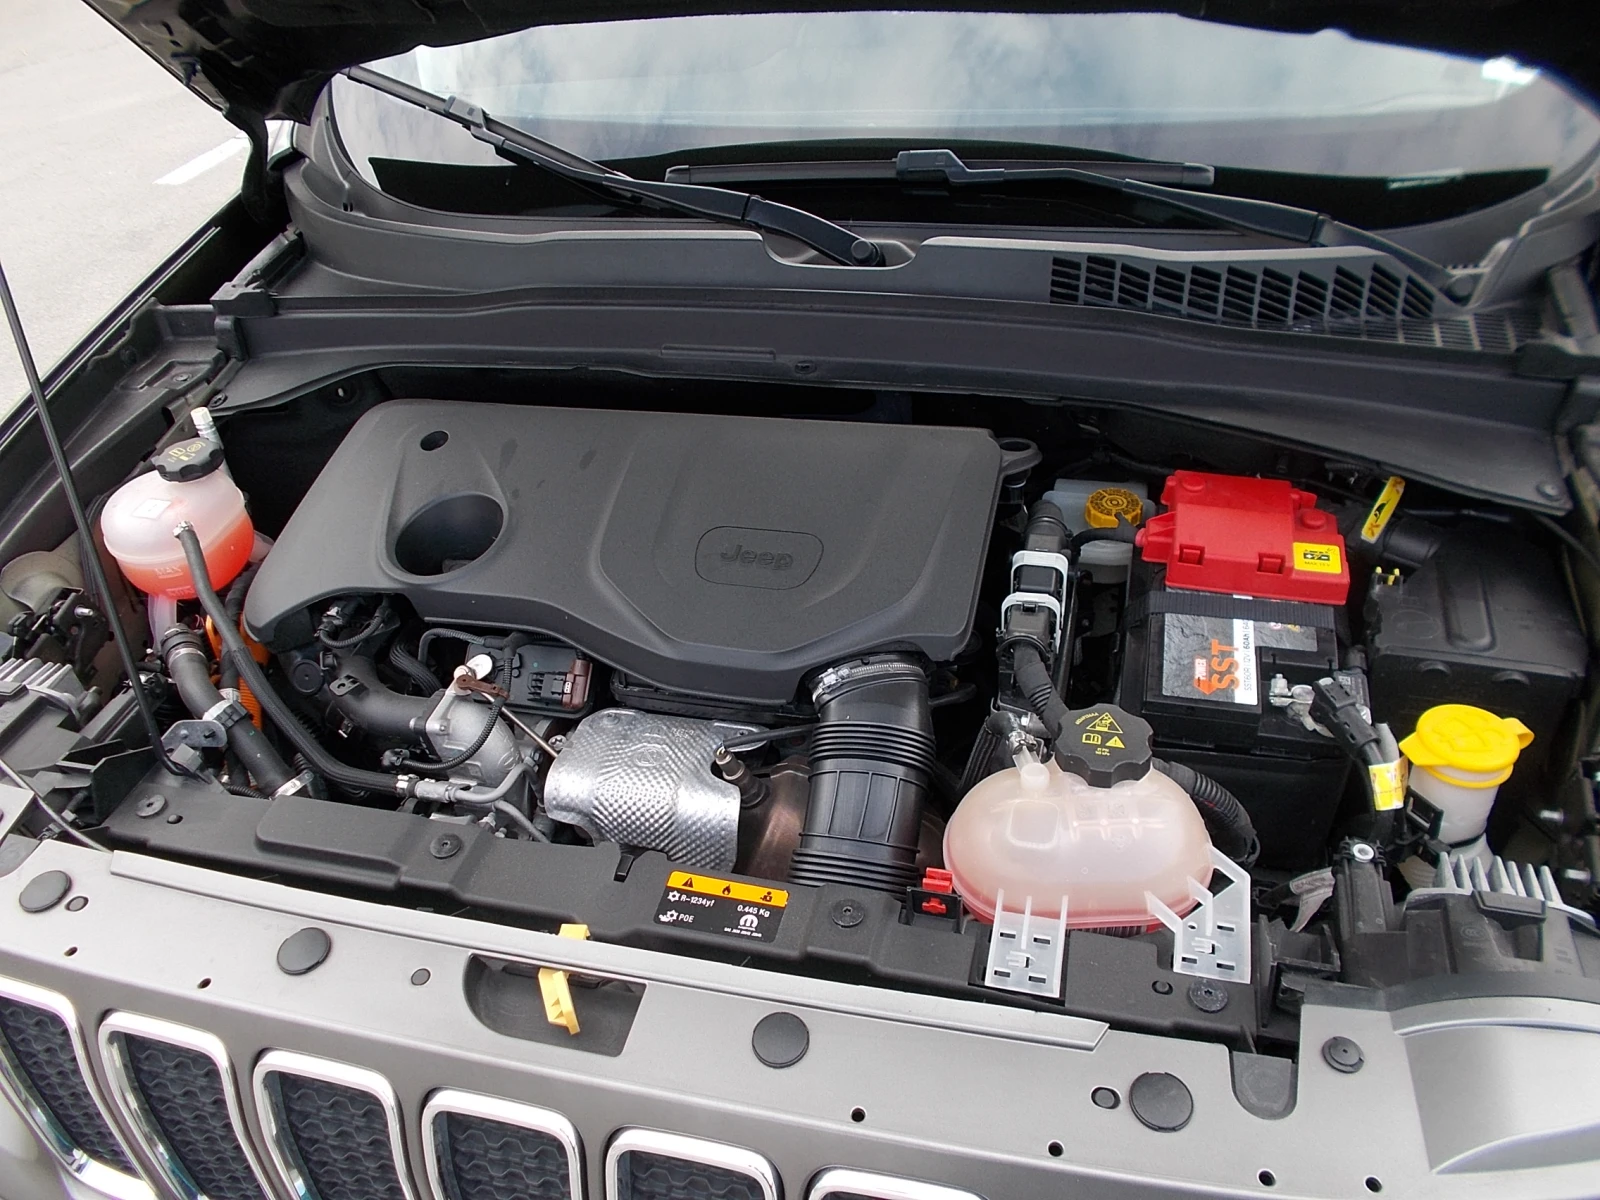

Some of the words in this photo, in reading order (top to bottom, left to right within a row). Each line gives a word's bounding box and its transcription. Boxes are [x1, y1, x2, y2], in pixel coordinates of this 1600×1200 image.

[720, 544, 794, 571] Jeep
[155, 565, 182, 575] MAX
[1242, 633, 1251, 650] 60Ah
[1195, 659, 1207, 680] POWER
[1211, 639, 1240, 690] SST
[680, 894, 714, 907] R-1234yf
[678, 913, 695, 923] POE
[737, 904, 758, 915] 0.445
[759, 907, 770, 917] Kg
